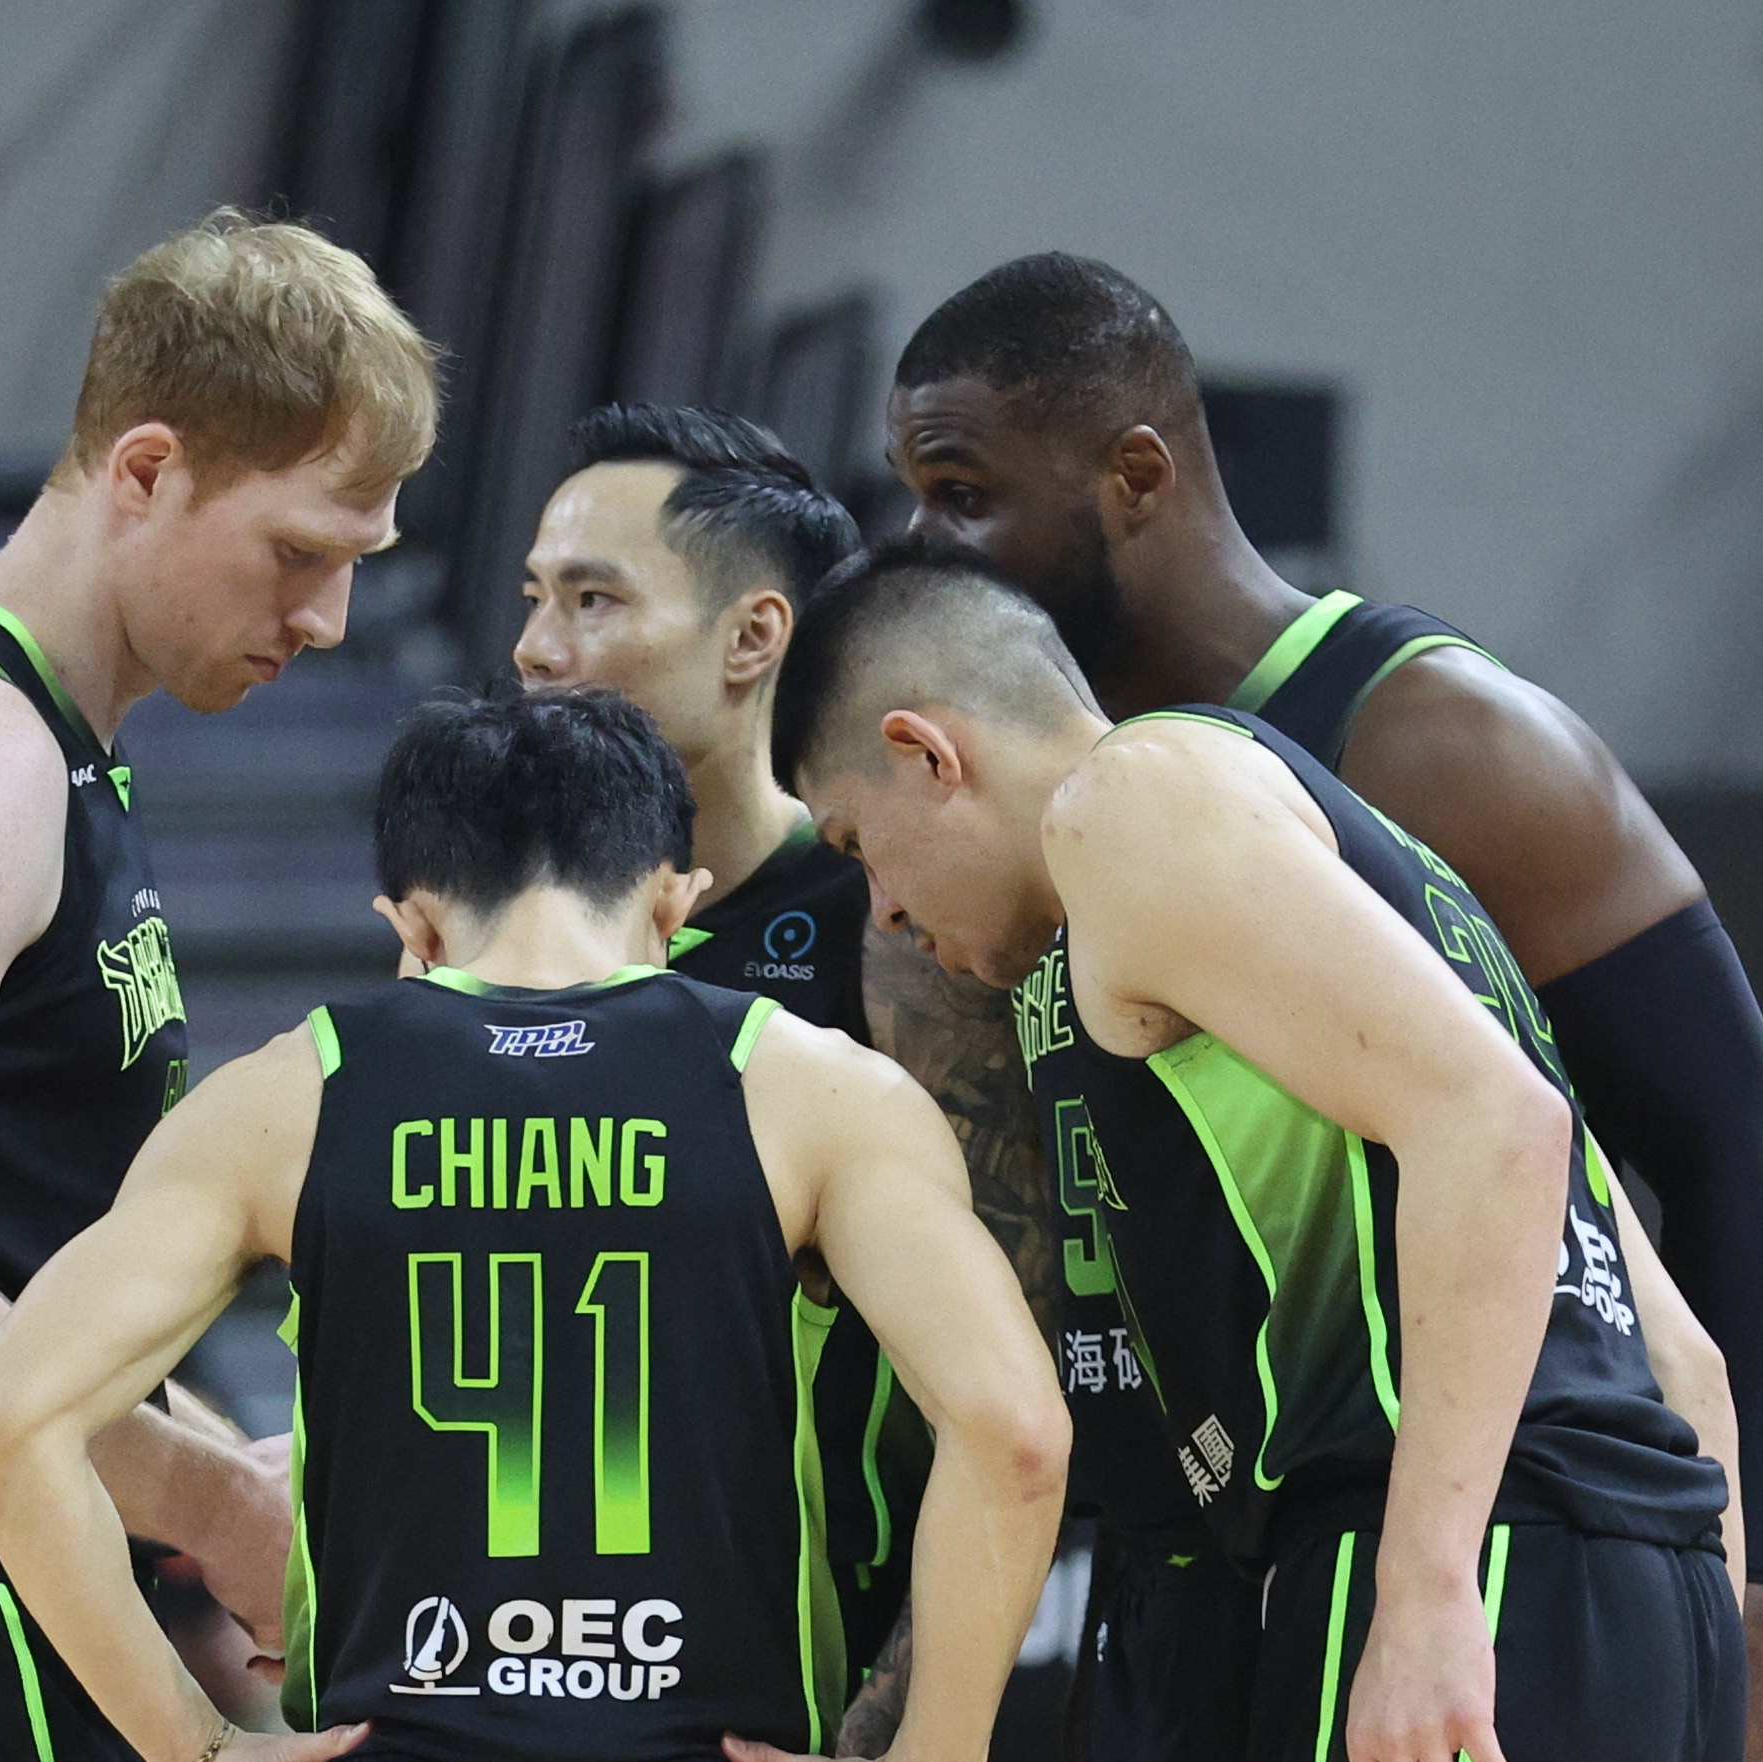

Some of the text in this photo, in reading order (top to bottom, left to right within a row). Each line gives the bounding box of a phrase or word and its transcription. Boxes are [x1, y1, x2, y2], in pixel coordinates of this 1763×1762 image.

[484, 1020, 596, 1058] TPBL
[391, 1117, 668, 1210] CHIANG
[408, 1251, 651, 1558] 41
[487, 1598, 685, 1663] OEC
[487, 1656, 682, 1702] GROUP
